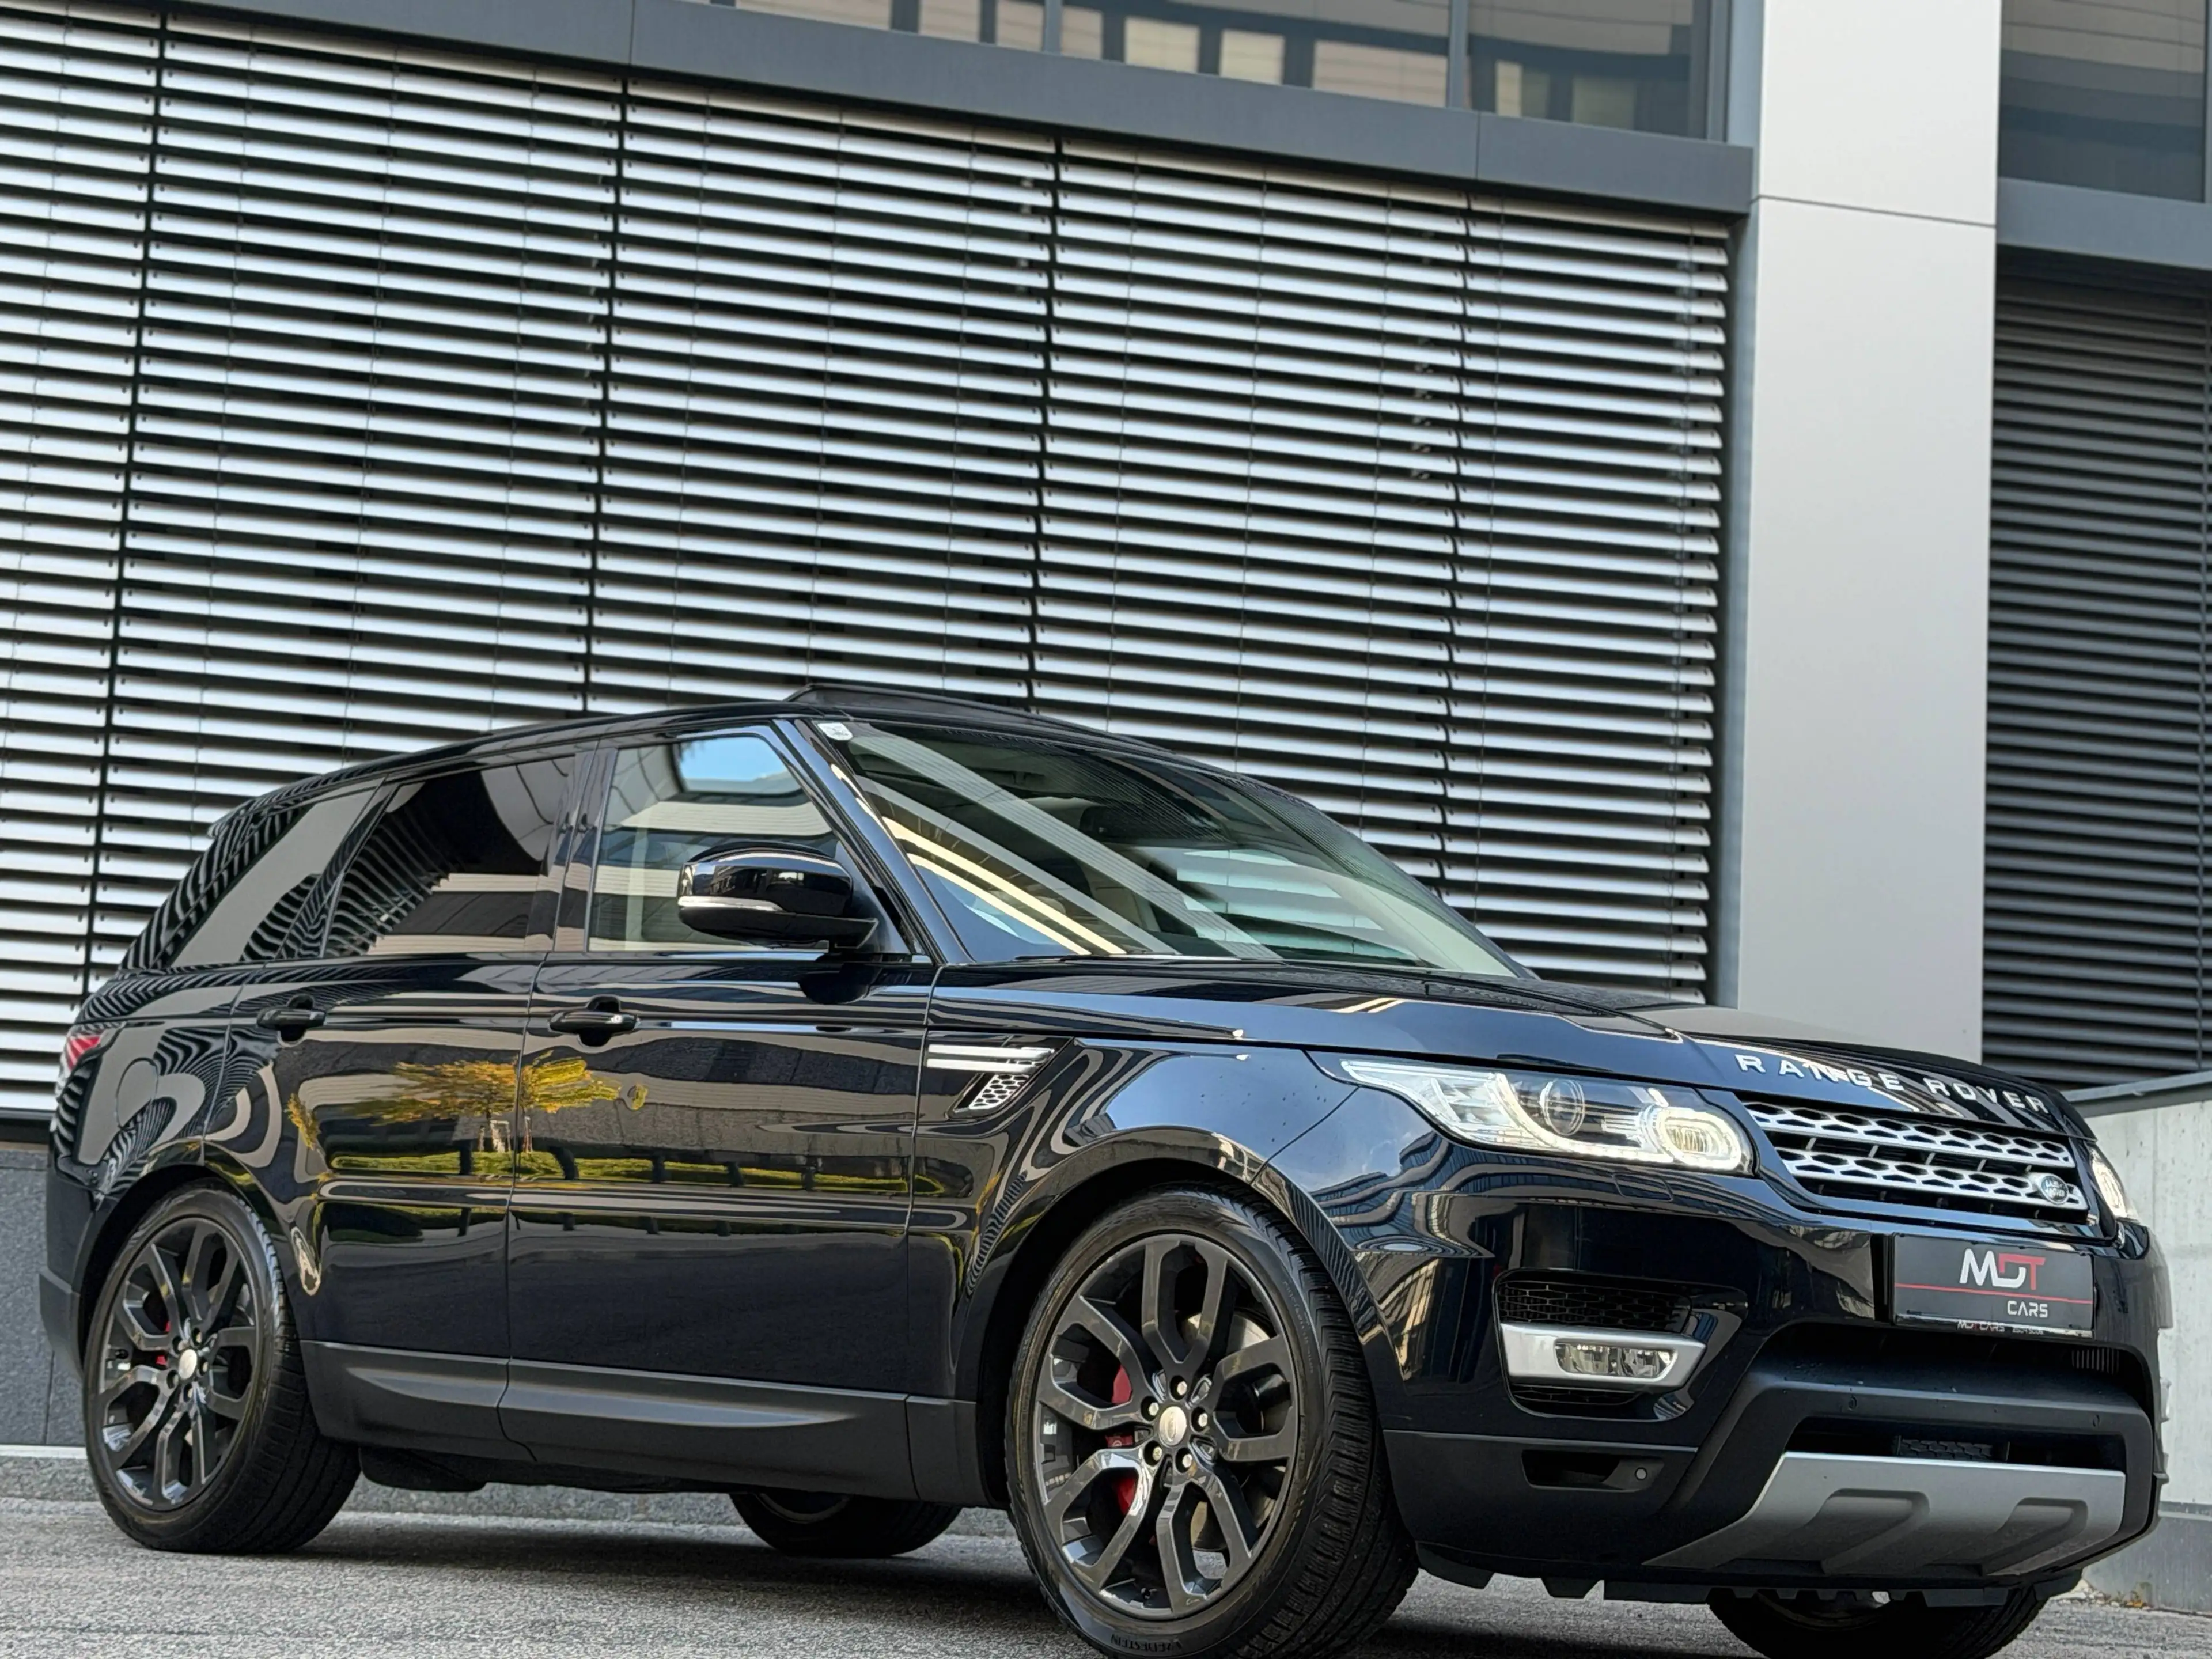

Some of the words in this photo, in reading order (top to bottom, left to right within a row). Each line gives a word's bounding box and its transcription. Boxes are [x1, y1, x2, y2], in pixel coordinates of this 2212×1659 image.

[1734, 1054, 1904, 1091] RANGE
[1923, 1077, 2048, 1114] ROVER
[1959, 1248, 2046, 1291] MDT
[2007, 1300, 2048, 1318] CARS
